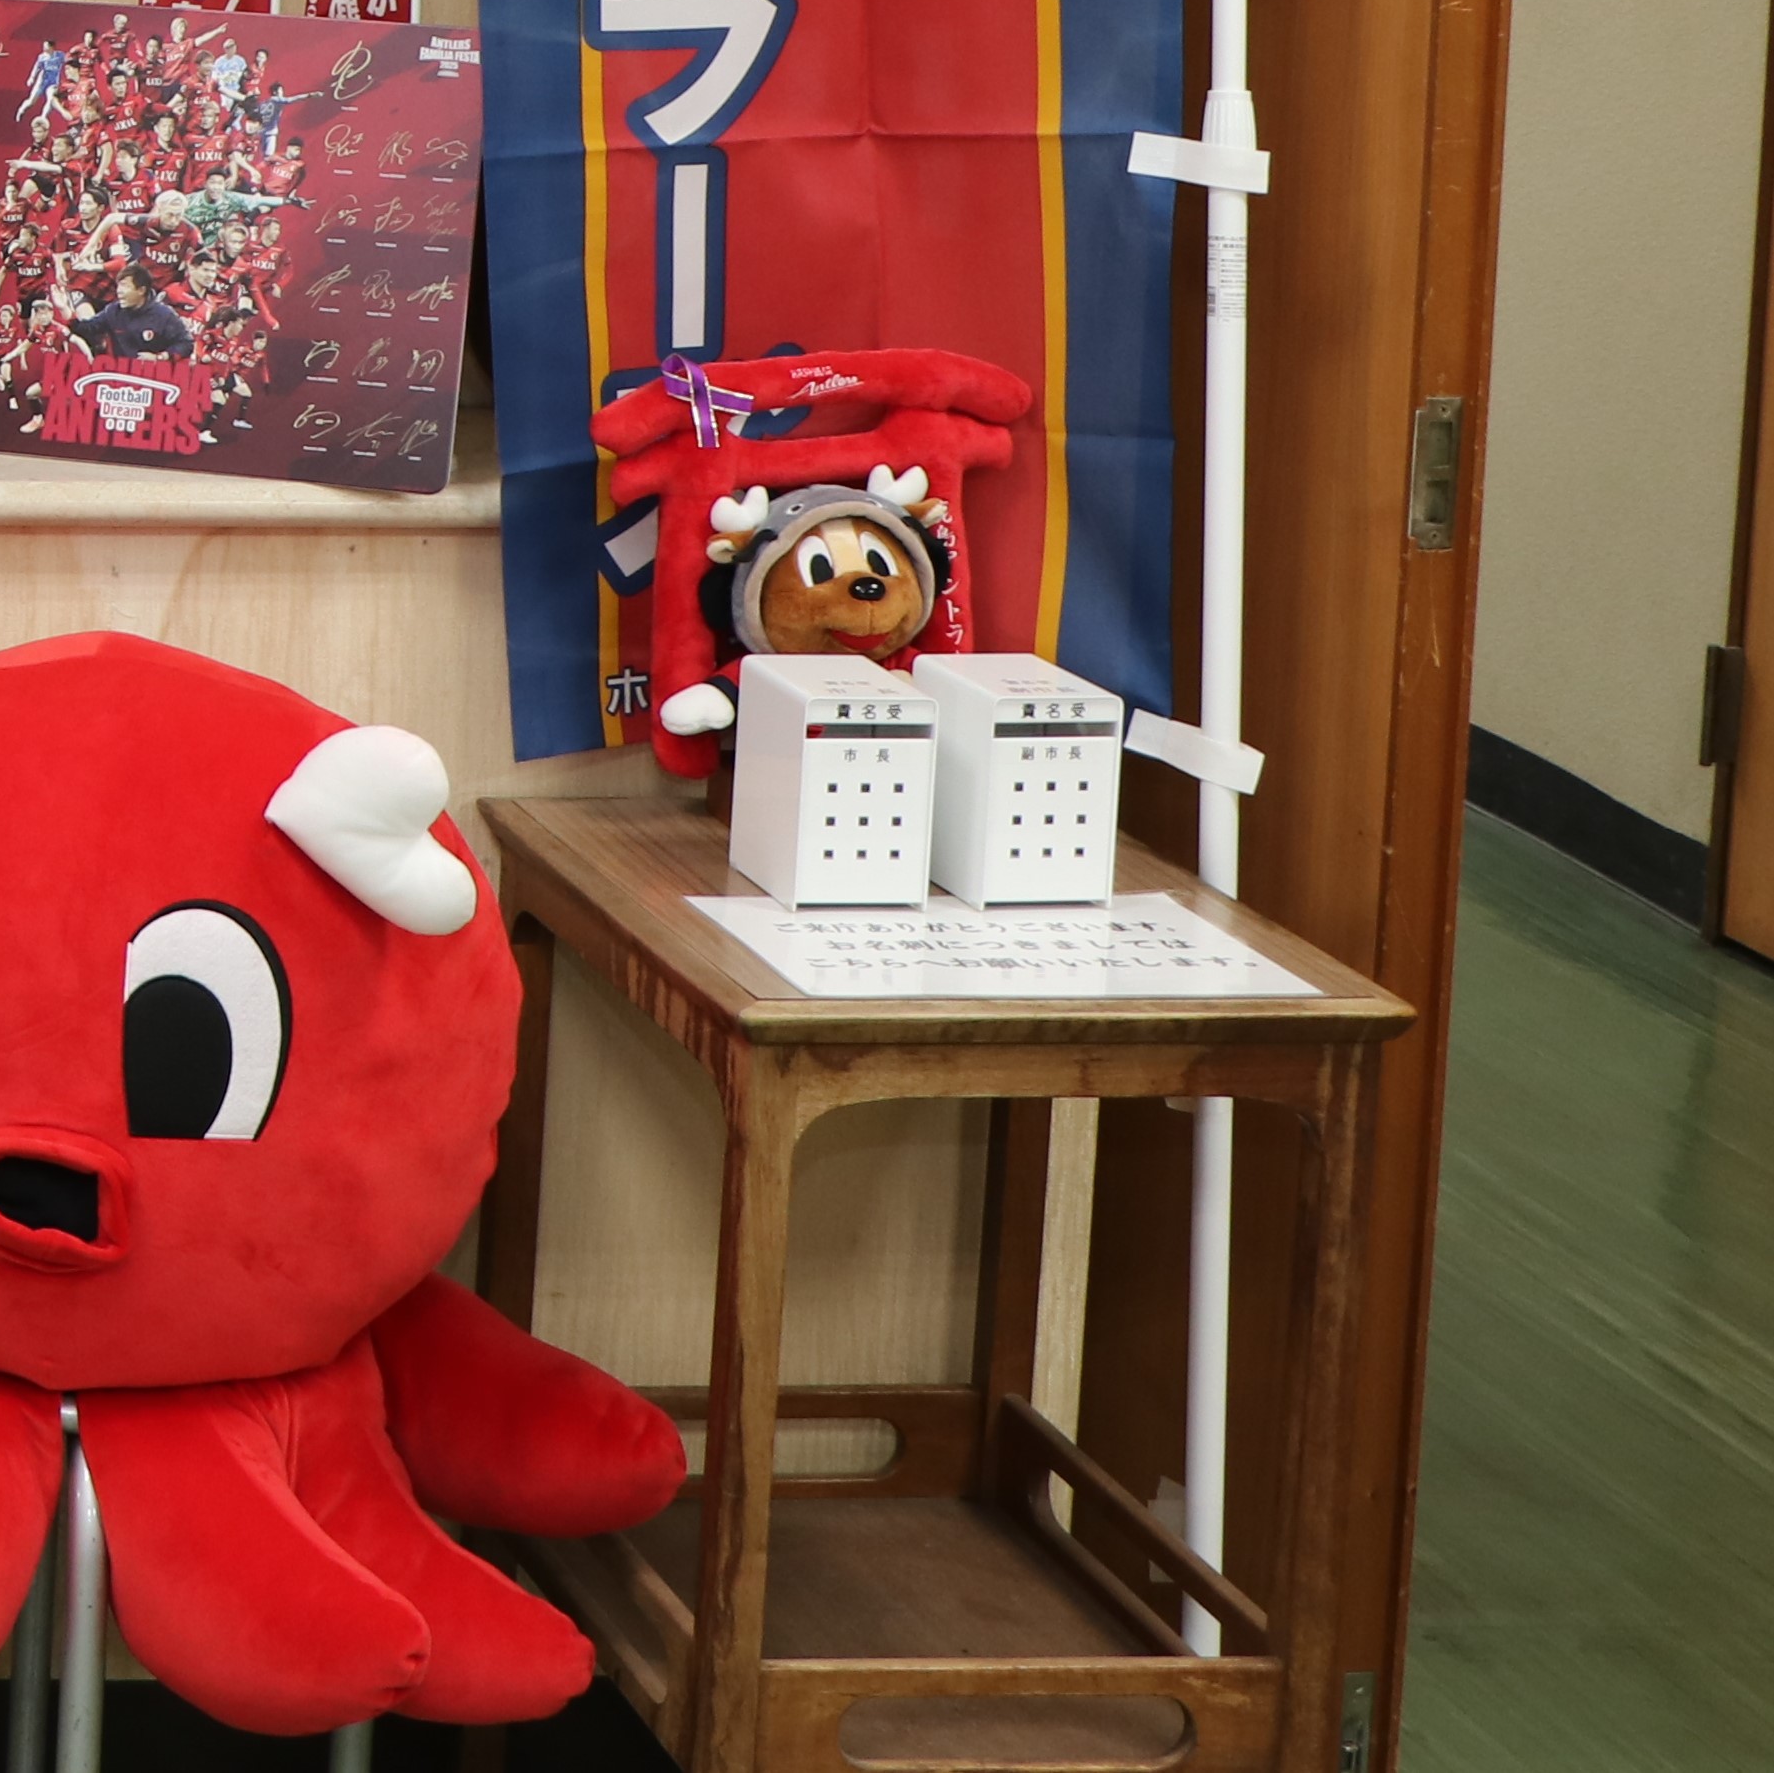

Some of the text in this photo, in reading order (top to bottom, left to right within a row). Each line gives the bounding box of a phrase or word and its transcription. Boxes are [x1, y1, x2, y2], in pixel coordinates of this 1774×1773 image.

[791, 373, 864, 399] Antlers
[99, 387, 150, 404] Football
[103, 403, 142, 417] Dream
[836, 701, 903, 721] 貴名受
[1020, 701, 1086, 721] 貴名受
[843, 749, 891, 762] 市長
[1021, 746, 1083, 762] 副市長
